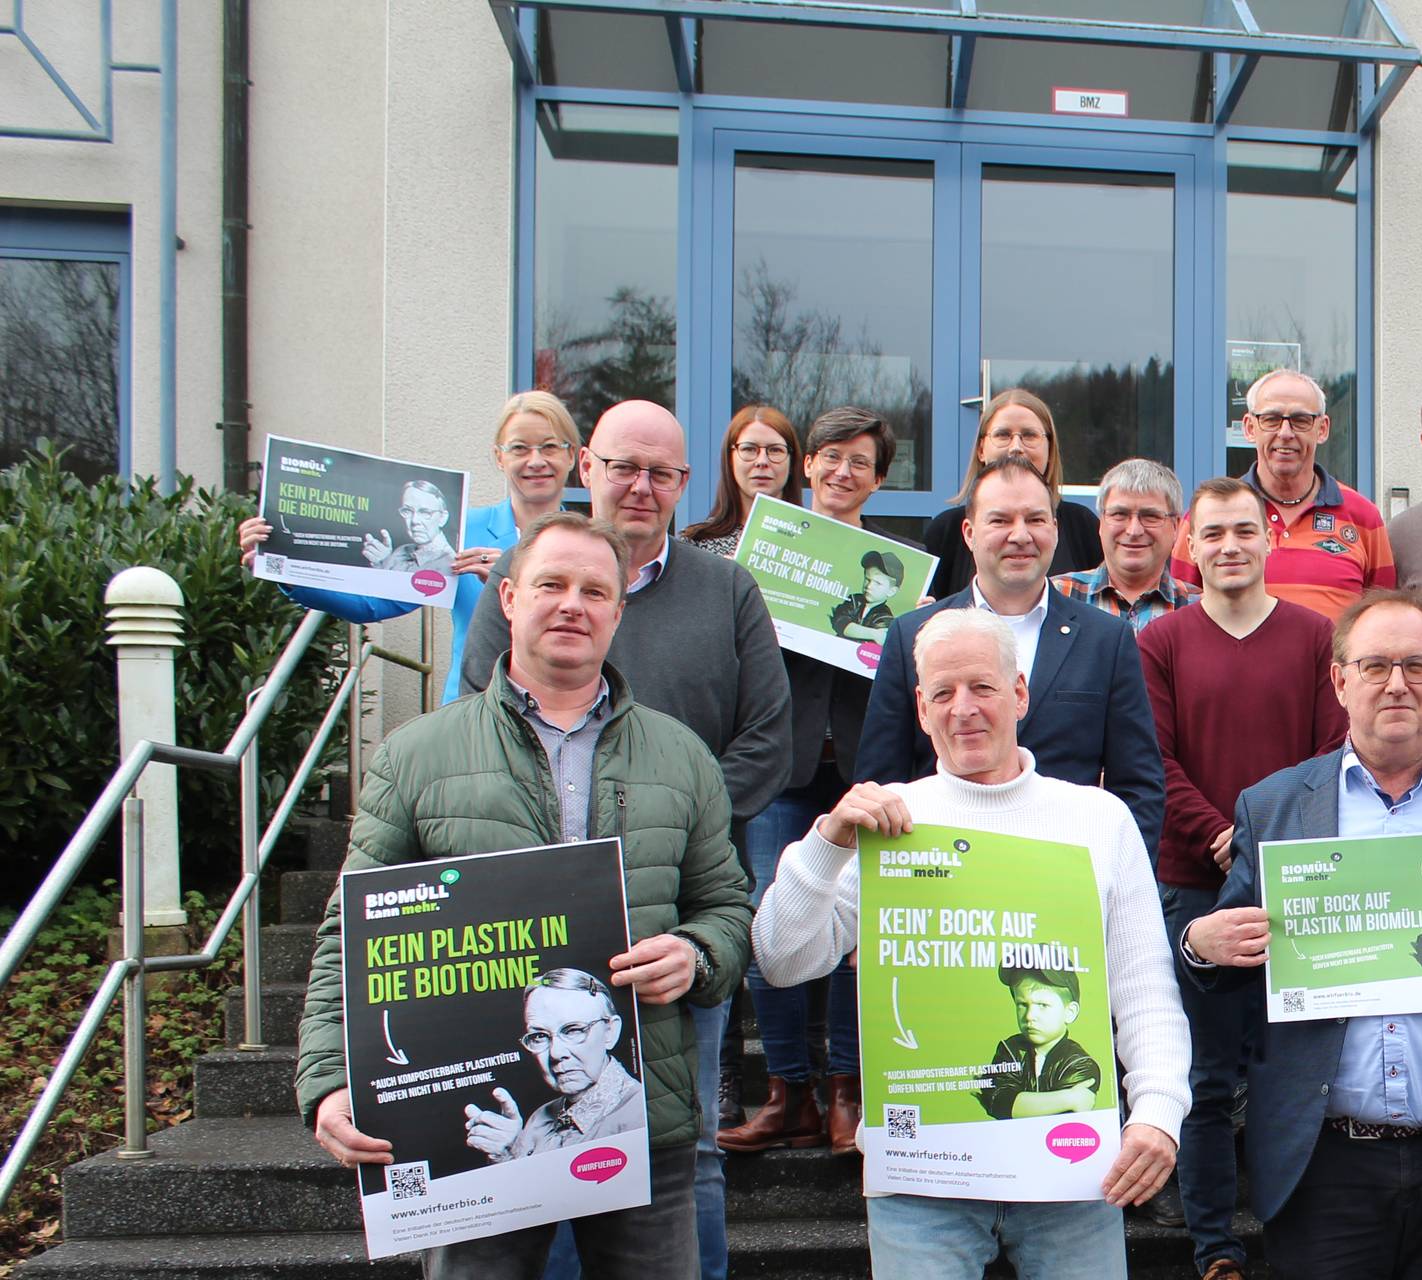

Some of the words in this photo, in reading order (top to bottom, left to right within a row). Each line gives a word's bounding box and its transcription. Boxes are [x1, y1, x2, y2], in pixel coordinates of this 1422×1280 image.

[1080, 96, 1101, 109] BMZ
[281, 456, 327, 472] BIOMÜLL
[280, 482, 306, 500] KEIN
[309, 487, 356, 509] PLASTIK
[357, 495, 369, 512] IN
[278, 498, 298, 516] DIE
[299, 501, 359, 526] BIOTONNE.
[763, 515, 802, 535] BIOMÜLL
[752, 539, 782, 558] KEIN'
[781, 548, 811, 570] BOCK
[810, 559, 833, 577] AUF
[747, 553, 792, 580] PLASTIK
[791, 568, 805, 585] IM
[805, 573, 851, 602] BIOMÜLL.
[880, 848, 962, 867] BIOMÜLL
[1281, 861, 1337, 875] BIOMÜLL
[880, 865, 912, 878] kann
[914, 866, 953, 879] mehr.
[1281, 875, 1304, 884] kann
[1304, 873, 1331, 881] mehr.
[365, 883, 449, 908] BIOMÜLL
[1283, 896, 1319, 916] KEIN'
[1324, 893, 1361, 914] BOCK
[1364, 891, 1391, 911] AUF
[365, 907, 400, 920] kann
[401, 901, 441, 915] mehr.
[879, 907, 933, 936] KEIN'
[939, 908, 996, 937] BOCK
[1001, 911, 1038, 939] AUF
[1284, 916, 1342, 937] PLASTIK
[1345, 914, 1362, 932] IM
[366, 931, 424, 968] KEIN
[431, 918, 536, 960] PLASTIK
[541, 915, 569, 948] IN
[879, 939, 965, 968] PLASTIK
[970, 941, 996, 968] IM
[1002, 941, 1090, 973] BIOMÜLL.
[367, 969, 409, 1005] DIE
[414, 954, 552, 999] BIOTONNE.
[397, 1062, 465, 1085] KOMPOSTIERBARE
[465, 1051, 521, 1072] PLASTIKTÜTEN
[906, 1066, 968, 1080] KOMPOSTIERBARE
[969, 1061, 1022, 1076] PLASTIKTÜTEN
[377, 1090, 408, 1104] DÜRFEN
[408, 1084, 431, 1098] NICHT
[432, 1082, 442, 1093] IN
[442, 1079, 455, 1091] DIE
[455, 1071, 496, 1088] BIOTONNE.
[888, 1083, 914, 1094] DÜRFEN
[914, 1082, 937, 1093] NICHT
[937, 1081, 945, 1091] IN
[945, 1080, 957, 1091] DIE
[958, 1078, 996, 1091] BIOTONNE.
[1052, 1137, 1096, 1147] #WIRFUERBIO
[577, 1158, 622, 1173] #WIRFUERBIO
[885, 1149, 973, 1162] www.wirfuerbio.de
[391, 1195, 494, 1220] www.wirfuerbio.de
